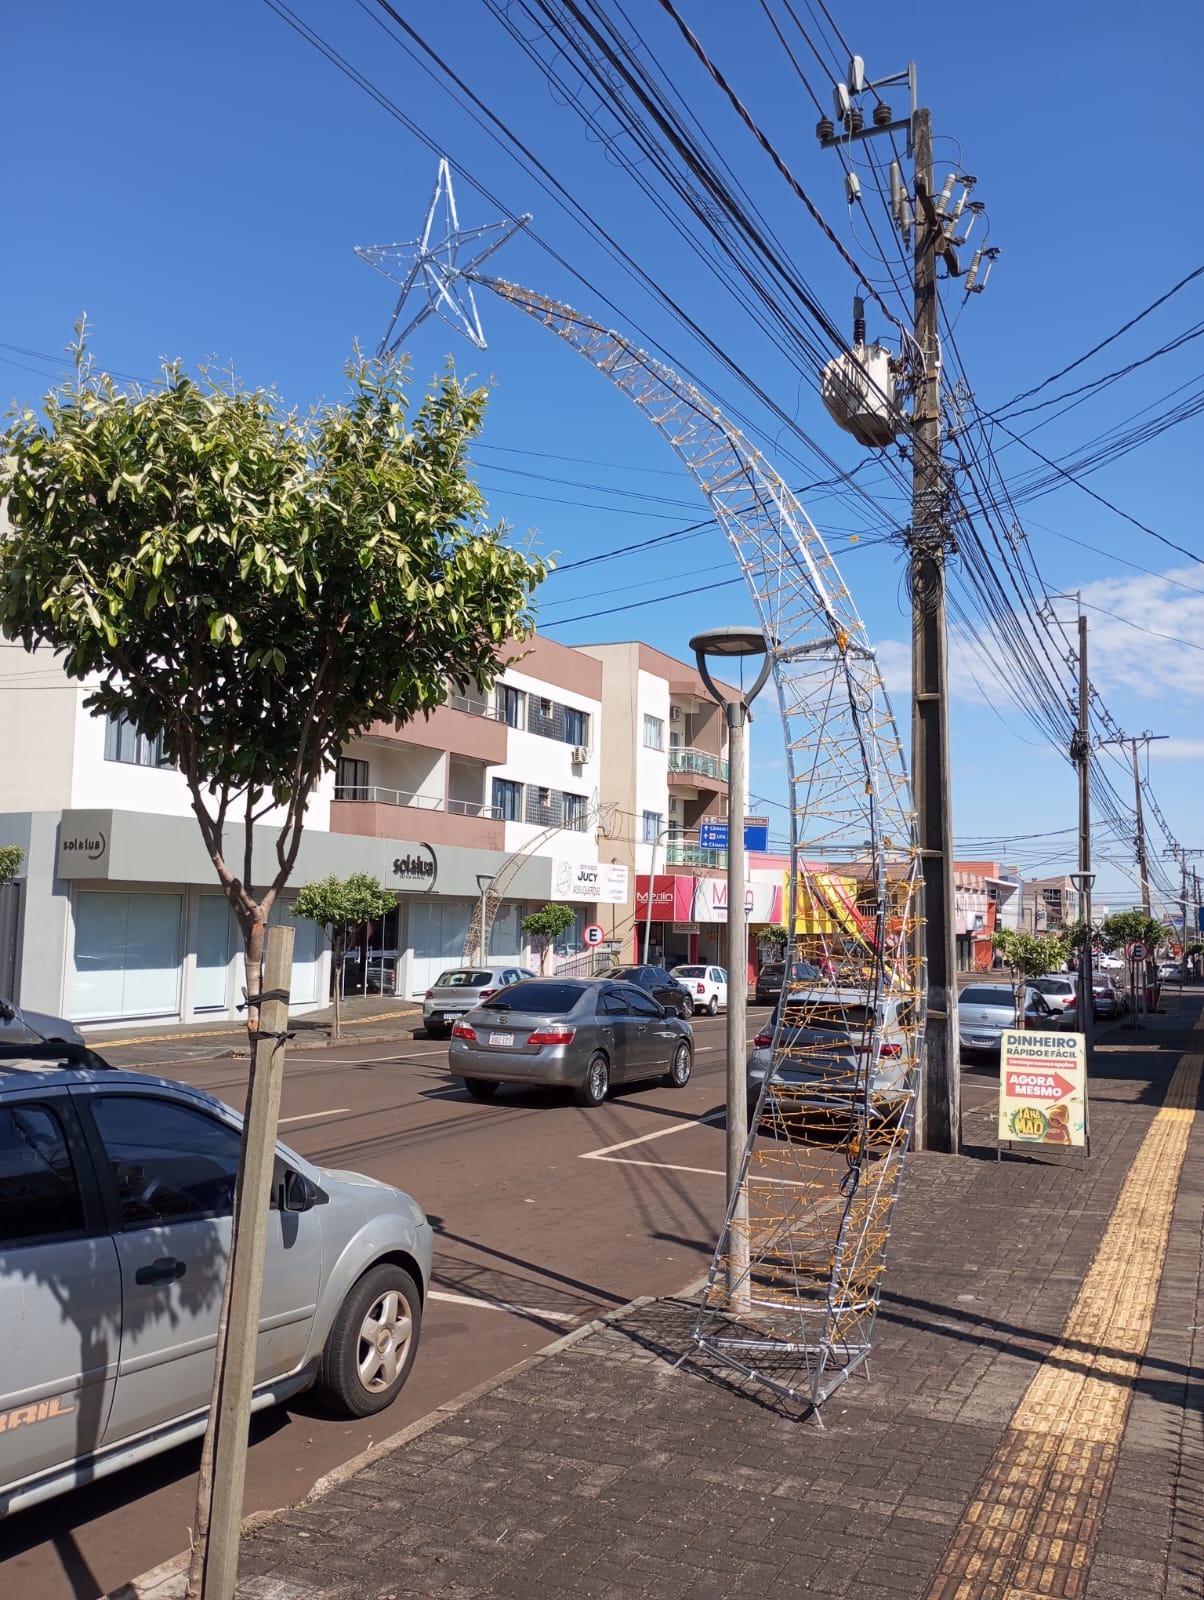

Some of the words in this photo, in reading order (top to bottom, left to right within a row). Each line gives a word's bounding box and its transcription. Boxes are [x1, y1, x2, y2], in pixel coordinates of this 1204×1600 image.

[577, 871, 598, 882] JUCY
[589, 929, 598, 942] E
[1007, 1035, 1077, 1048] DINHEIRO
[1006, 1046, 1043, 1057] RÁPIDO
[1050, 1049, 1077, 1058] FÁCIL
[1010, 1074, 1055, 1086] AGORA
[1014, 1085, 1062, 1097] MESMO
